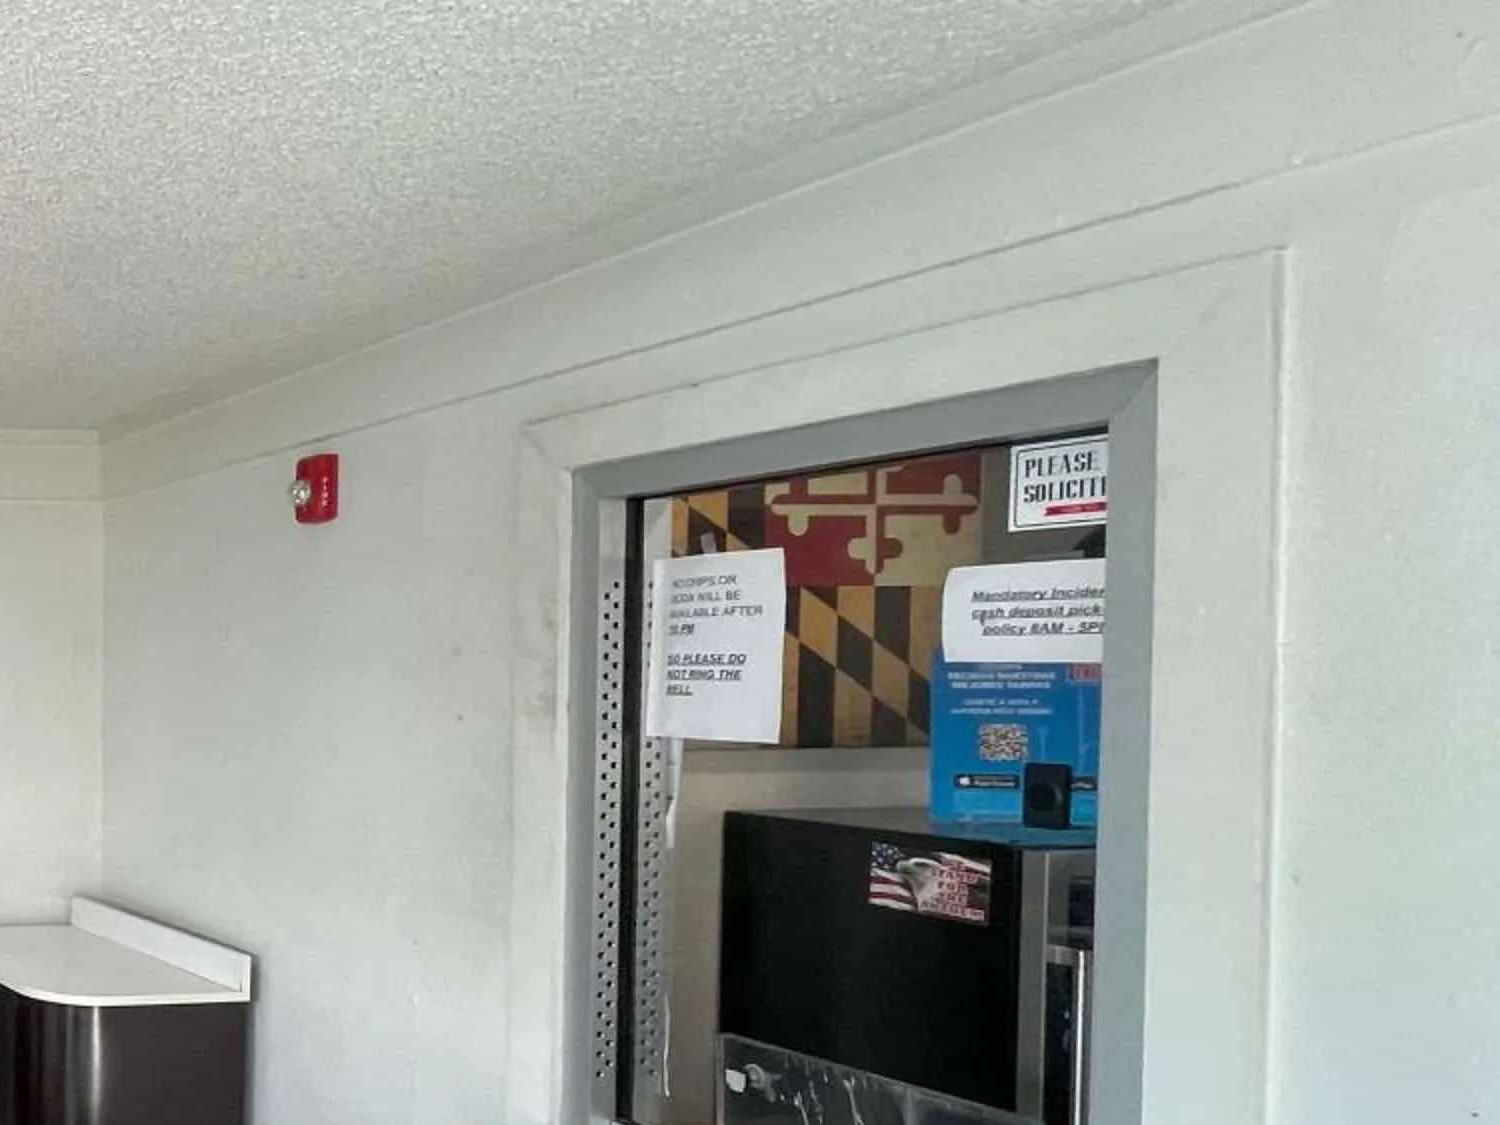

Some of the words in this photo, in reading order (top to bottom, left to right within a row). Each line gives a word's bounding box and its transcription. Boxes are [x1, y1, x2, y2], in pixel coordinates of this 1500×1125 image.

[1025, 452, 1100, 477] PLEASE
[697, 590, 722, 601] WILL
[725, 590, 741, 601] BE
[972, 588, 1047, 602] Mandatory
[723, 605, 762, 616] AFTER
[1008, 606, 1065, 619] deposit
[982, 622, 1027, 636] policy
[683, 654, 725, 666] PLEASE
[727, 653, 747, 665] DO
[667, 670, 687, 681] NOT
[718, 670, 742, 681] THE
